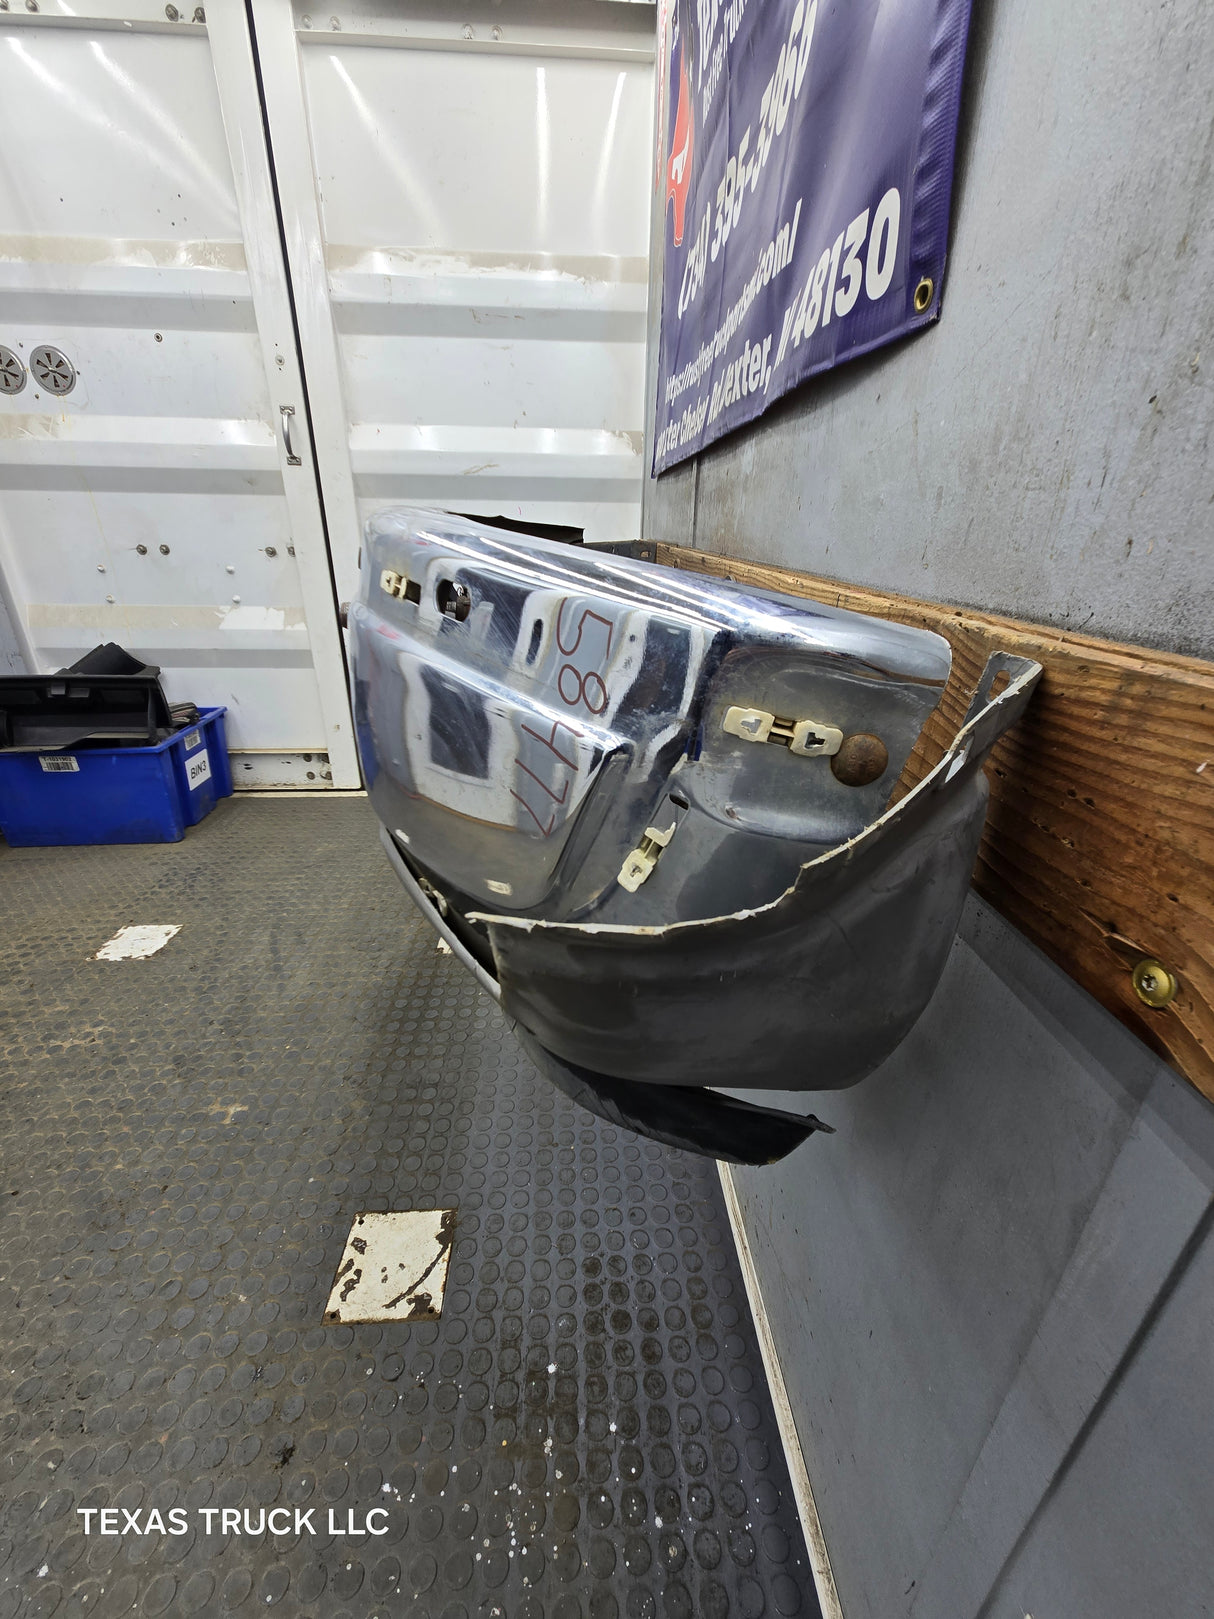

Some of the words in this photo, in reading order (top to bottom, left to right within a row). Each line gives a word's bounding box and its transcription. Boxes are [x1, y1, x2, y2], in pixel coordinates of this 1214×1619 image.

[791, 187, 900, 348] 48130
[191, 760, 206, 779] BIN3
[509, 597, 614, 838] 58477
